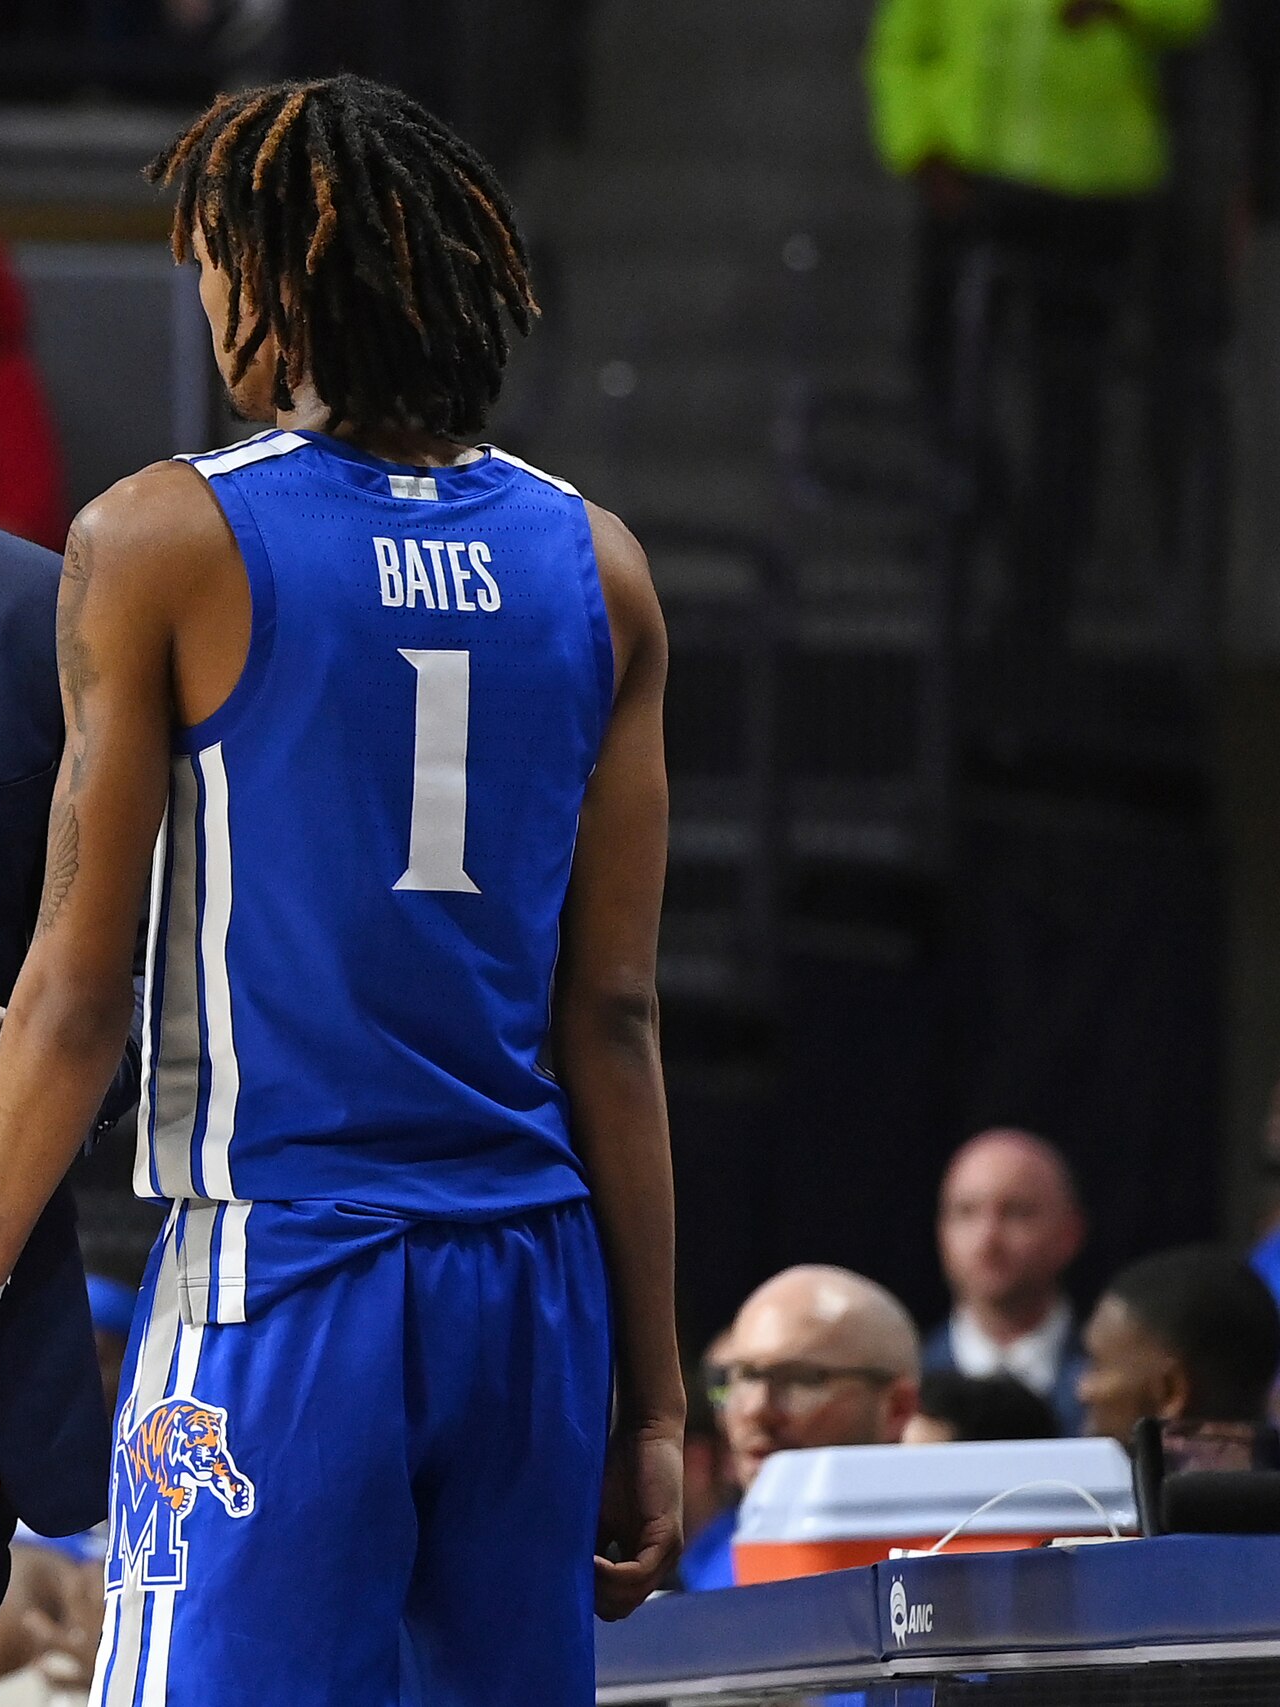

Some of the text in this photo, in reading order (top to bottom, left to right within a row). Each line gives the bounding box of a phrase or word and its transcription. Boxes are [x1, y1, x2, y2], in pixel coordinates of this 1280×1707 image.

[373, 536, 502, 613] BATES
[391, 647, 482, 894] 1
[908, 1603, 933, 1634] ANC
